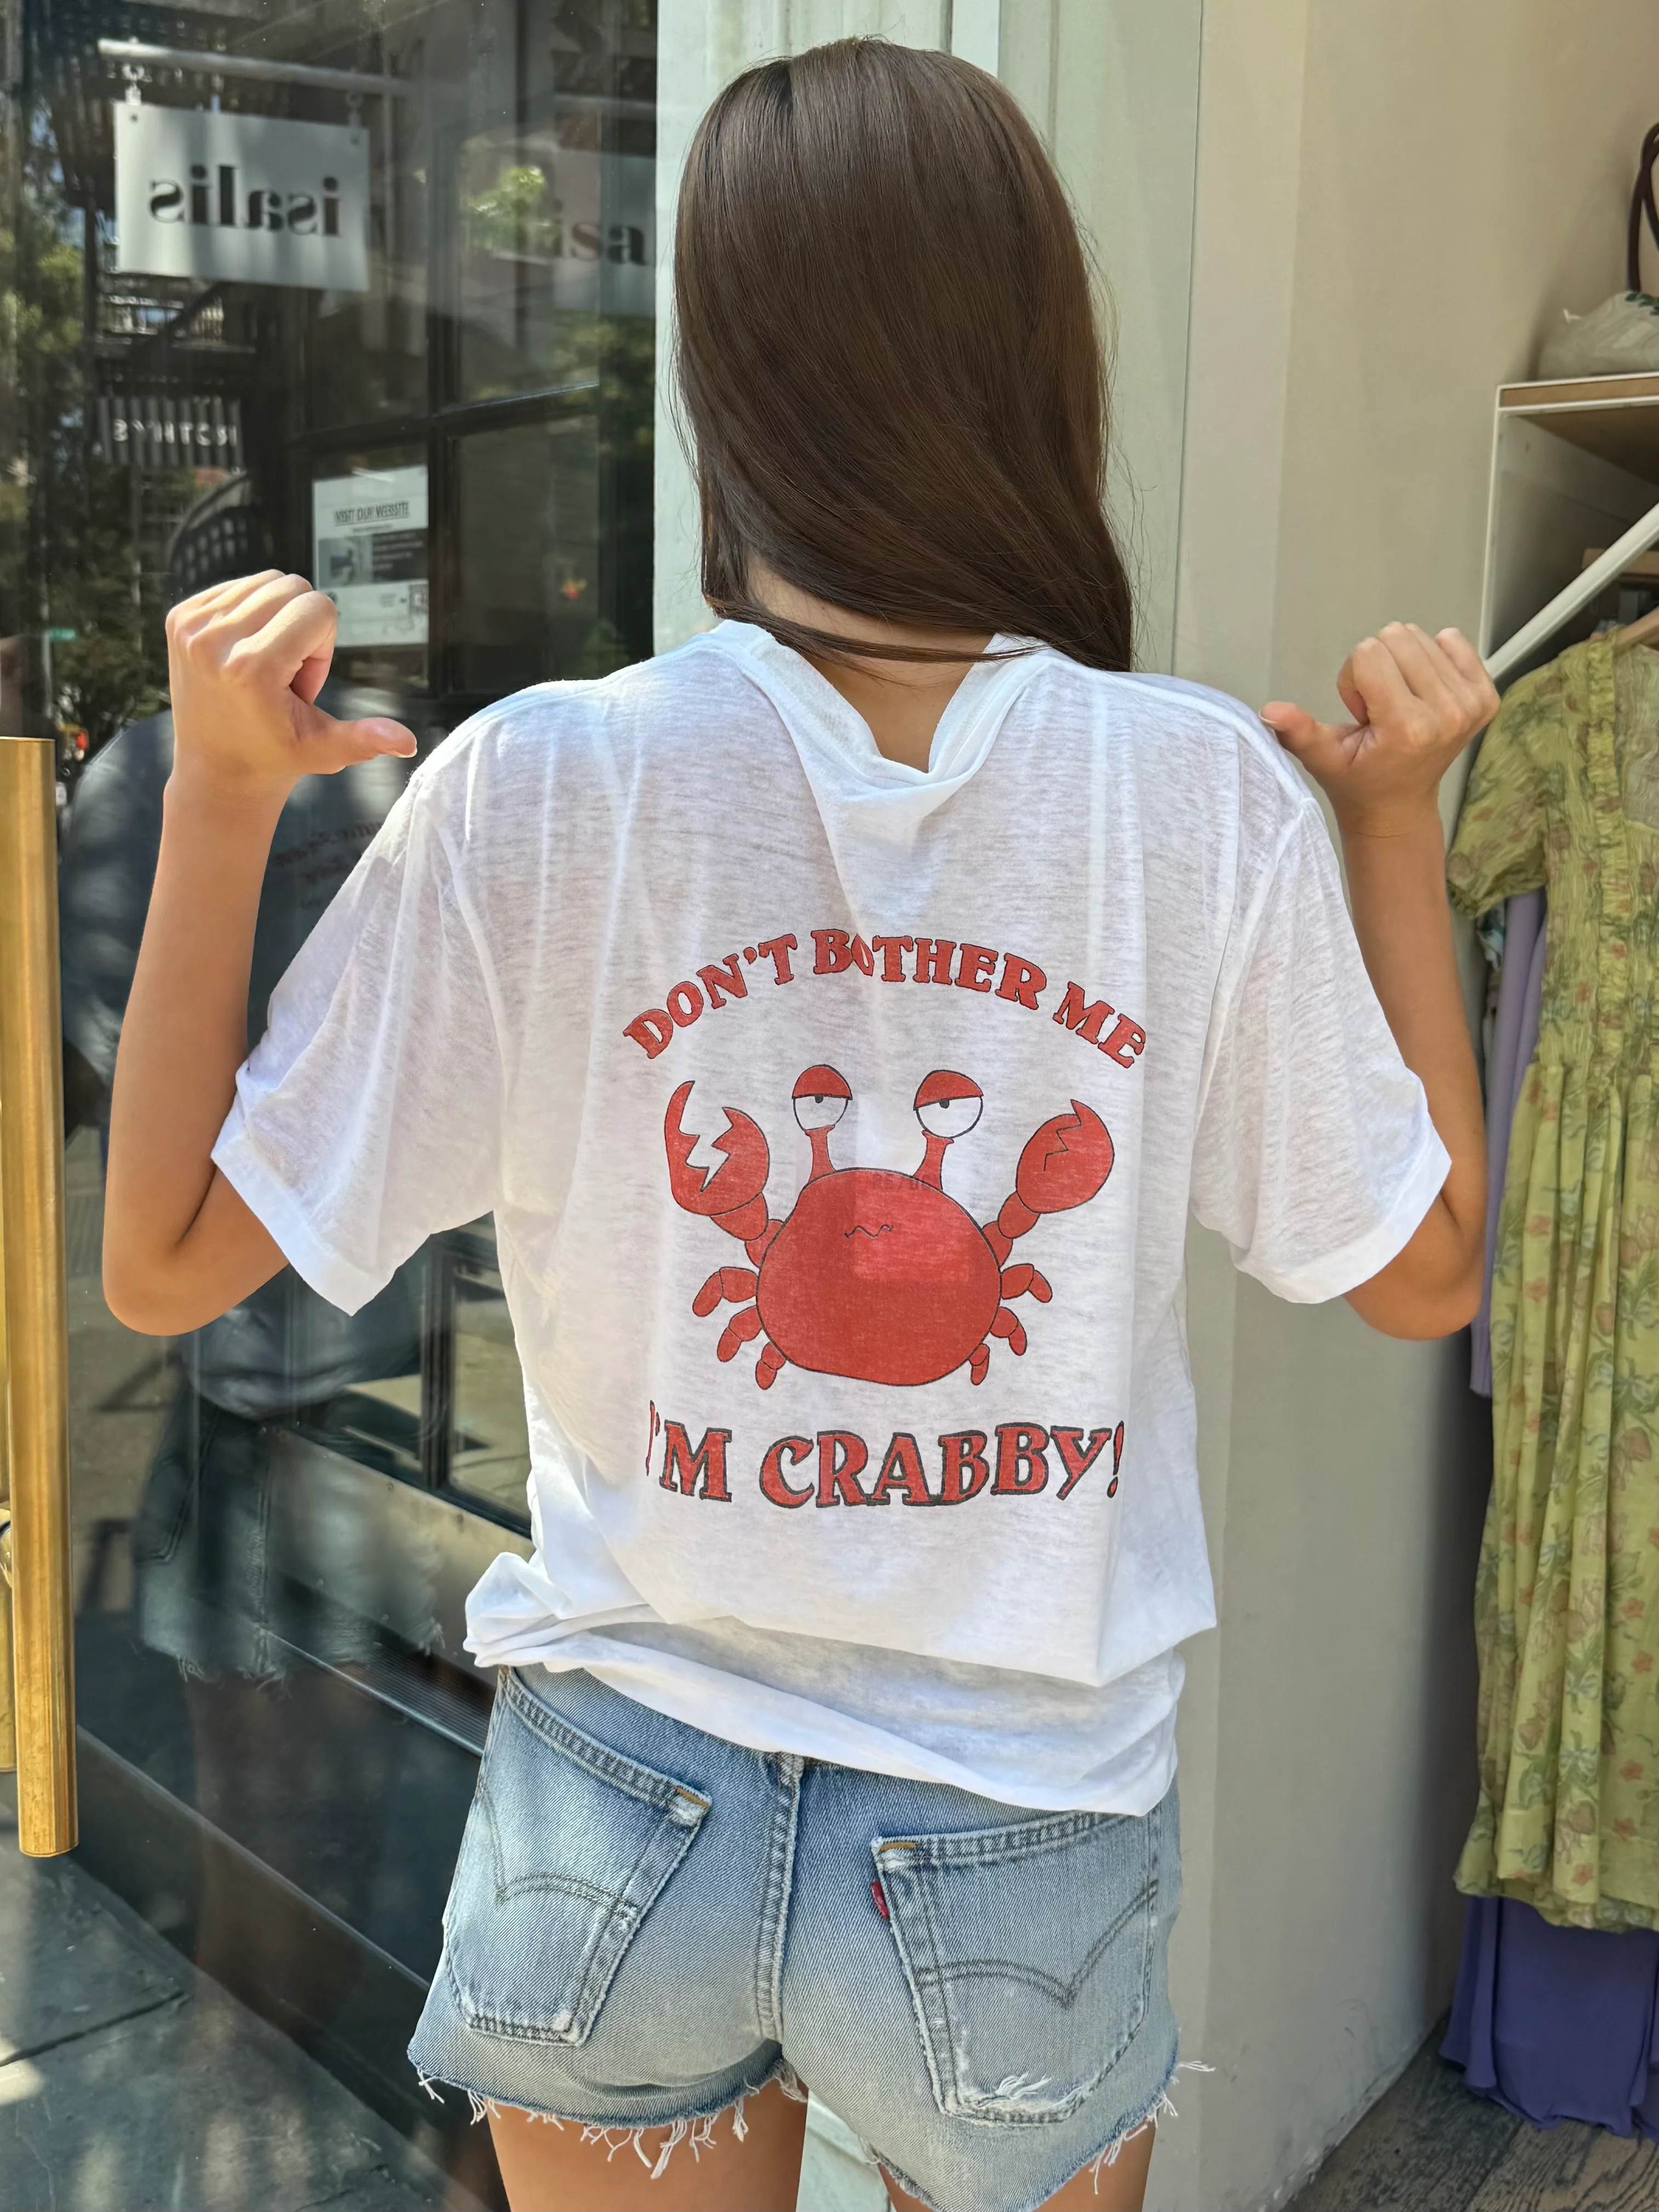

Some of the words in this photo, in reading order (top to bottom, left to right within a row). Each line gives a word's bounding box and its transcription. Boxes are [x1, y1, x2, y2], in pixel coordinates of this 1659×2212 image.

[376, 502, 409, 519] WEBSITE
[623, 933, 798, 1060] DON'T
[811, 928, 1048, 1010] BOTHER
[1053, 981, 1147, 1068] ME
[760, 1421, 1125, 1509] CRABBY!
